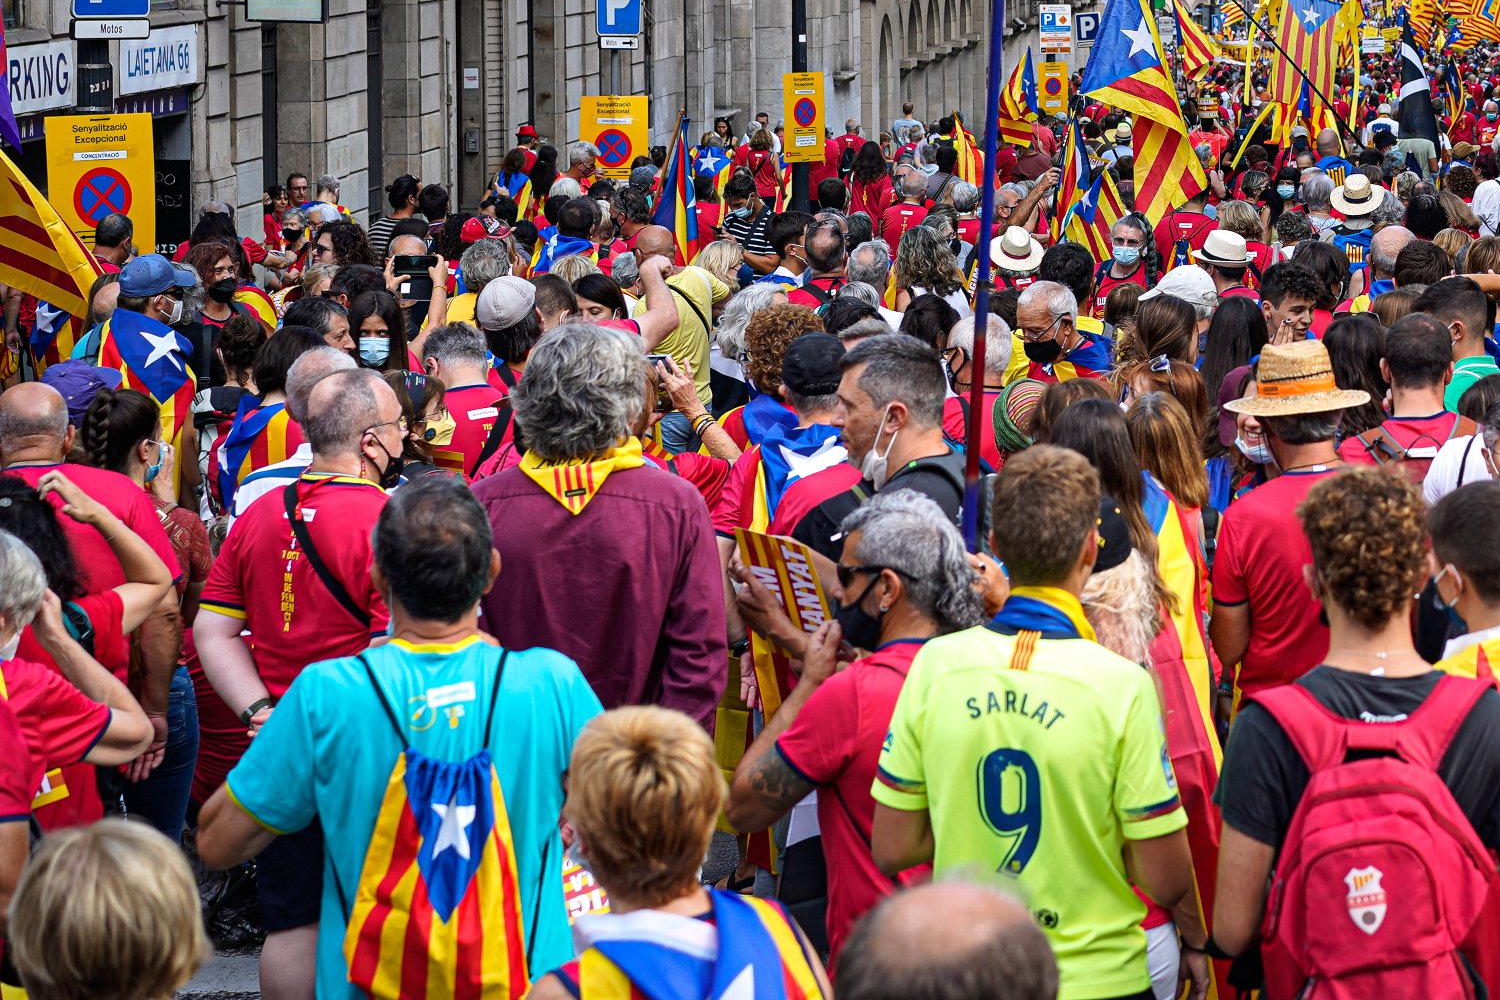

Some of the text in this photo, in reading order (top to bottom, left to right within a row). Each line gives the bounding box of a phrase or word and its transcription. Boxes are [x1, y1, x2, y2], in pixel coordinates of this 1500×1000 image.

[100, 23, 123, 34] Motos
[1043, 13, 1053, 26] P
[1080, 16, 1096, 39] P
[127, 42, 190, 79] LAIETANA 66
[9, 51, 70, 102] RKING
[72, 122, 128, 134] Senyalització
[74, 134, 127, 145] Excepcional
[286, 551, 300, 561] OCT
[966, 690, 1065, 730] SARLAT
[976, 747, 1042, 880] 9
